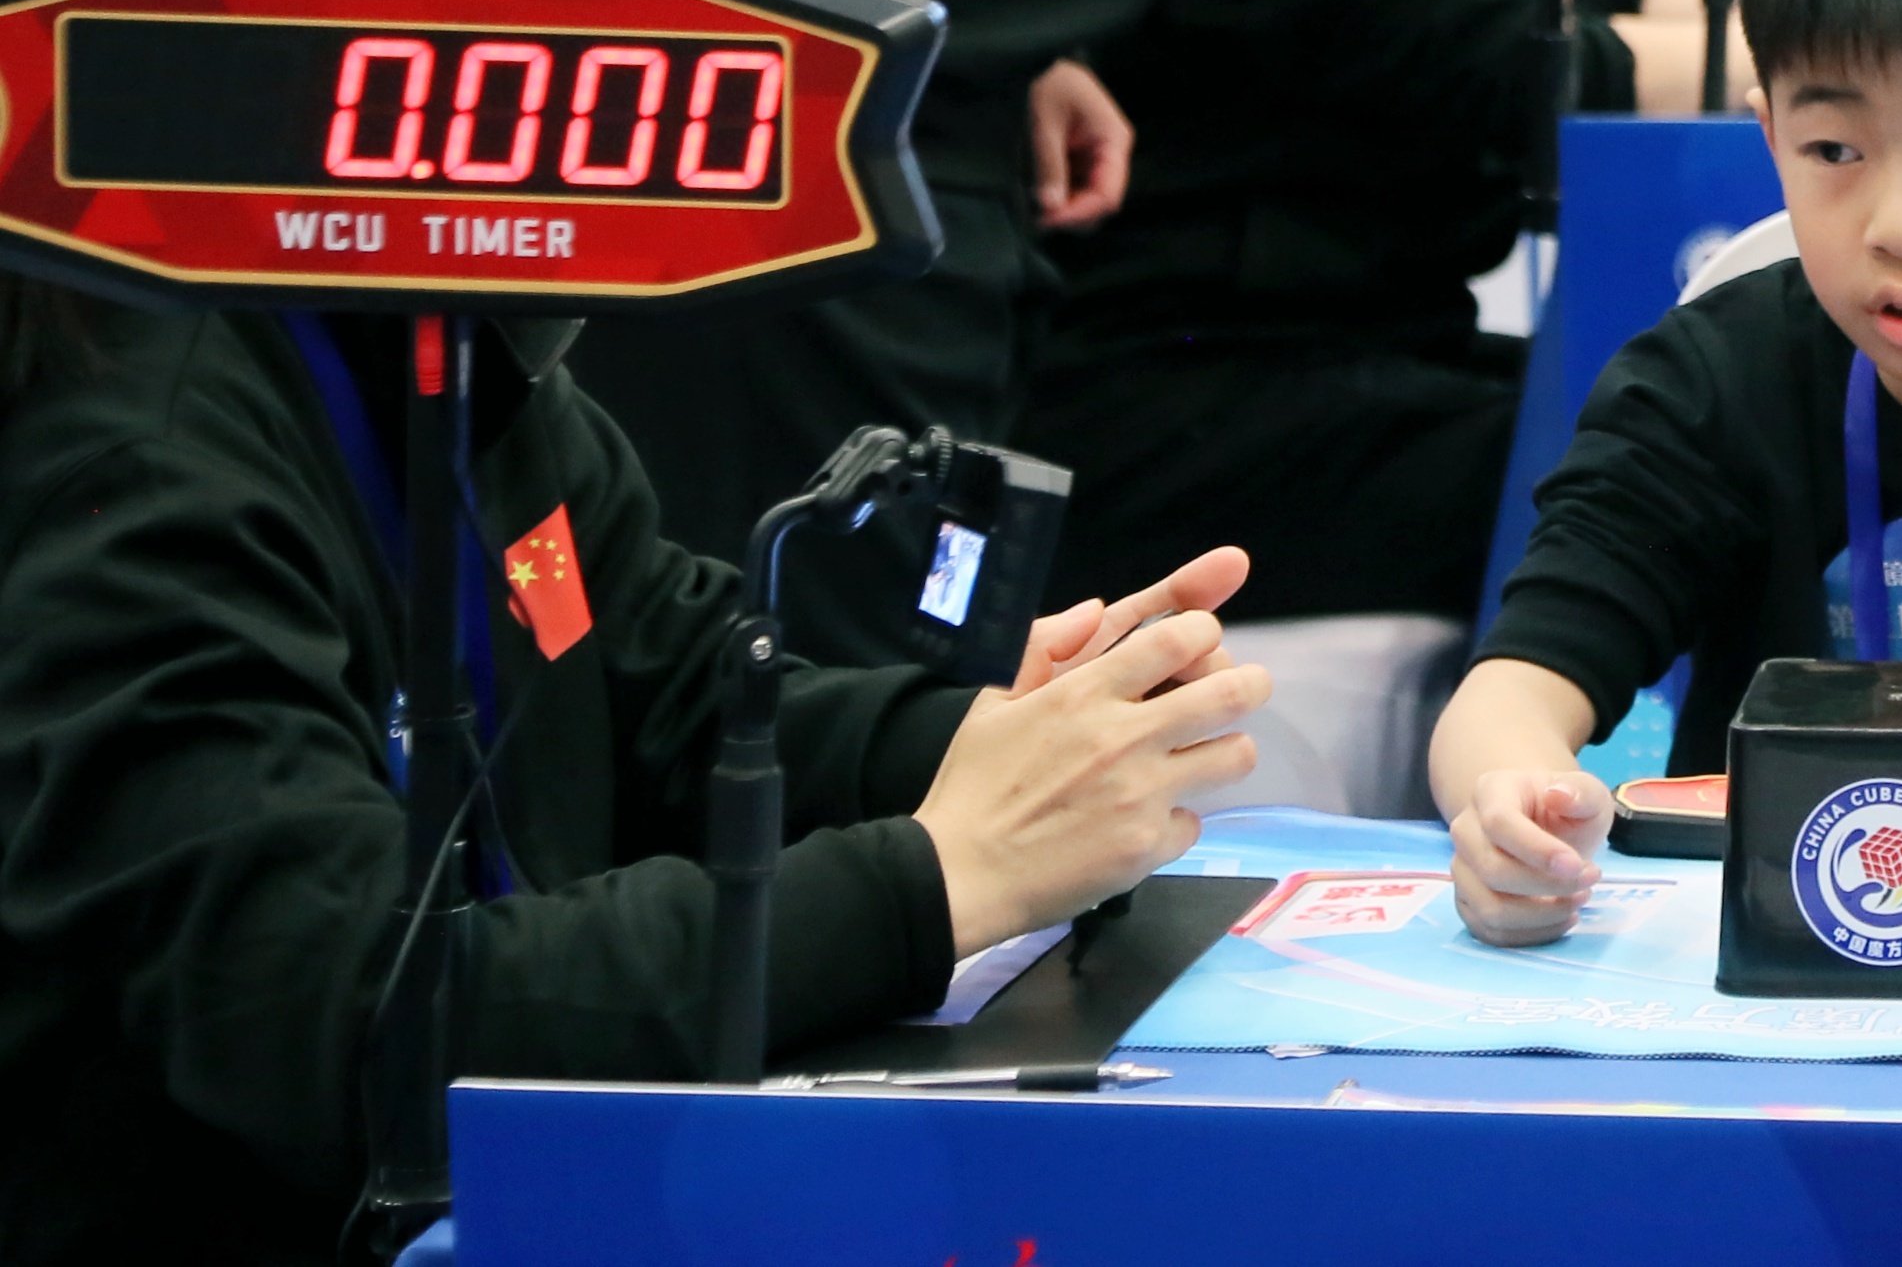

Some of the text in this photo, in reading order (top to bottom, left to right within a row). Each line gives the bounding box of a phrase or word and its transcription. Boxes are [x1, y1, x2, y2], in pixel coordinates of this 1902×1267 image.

[324, 37, 784, 190] 0.000
[275, 211, 576, 259] WCU TIMER
[1802, 803, 1846, 860] CHINA
